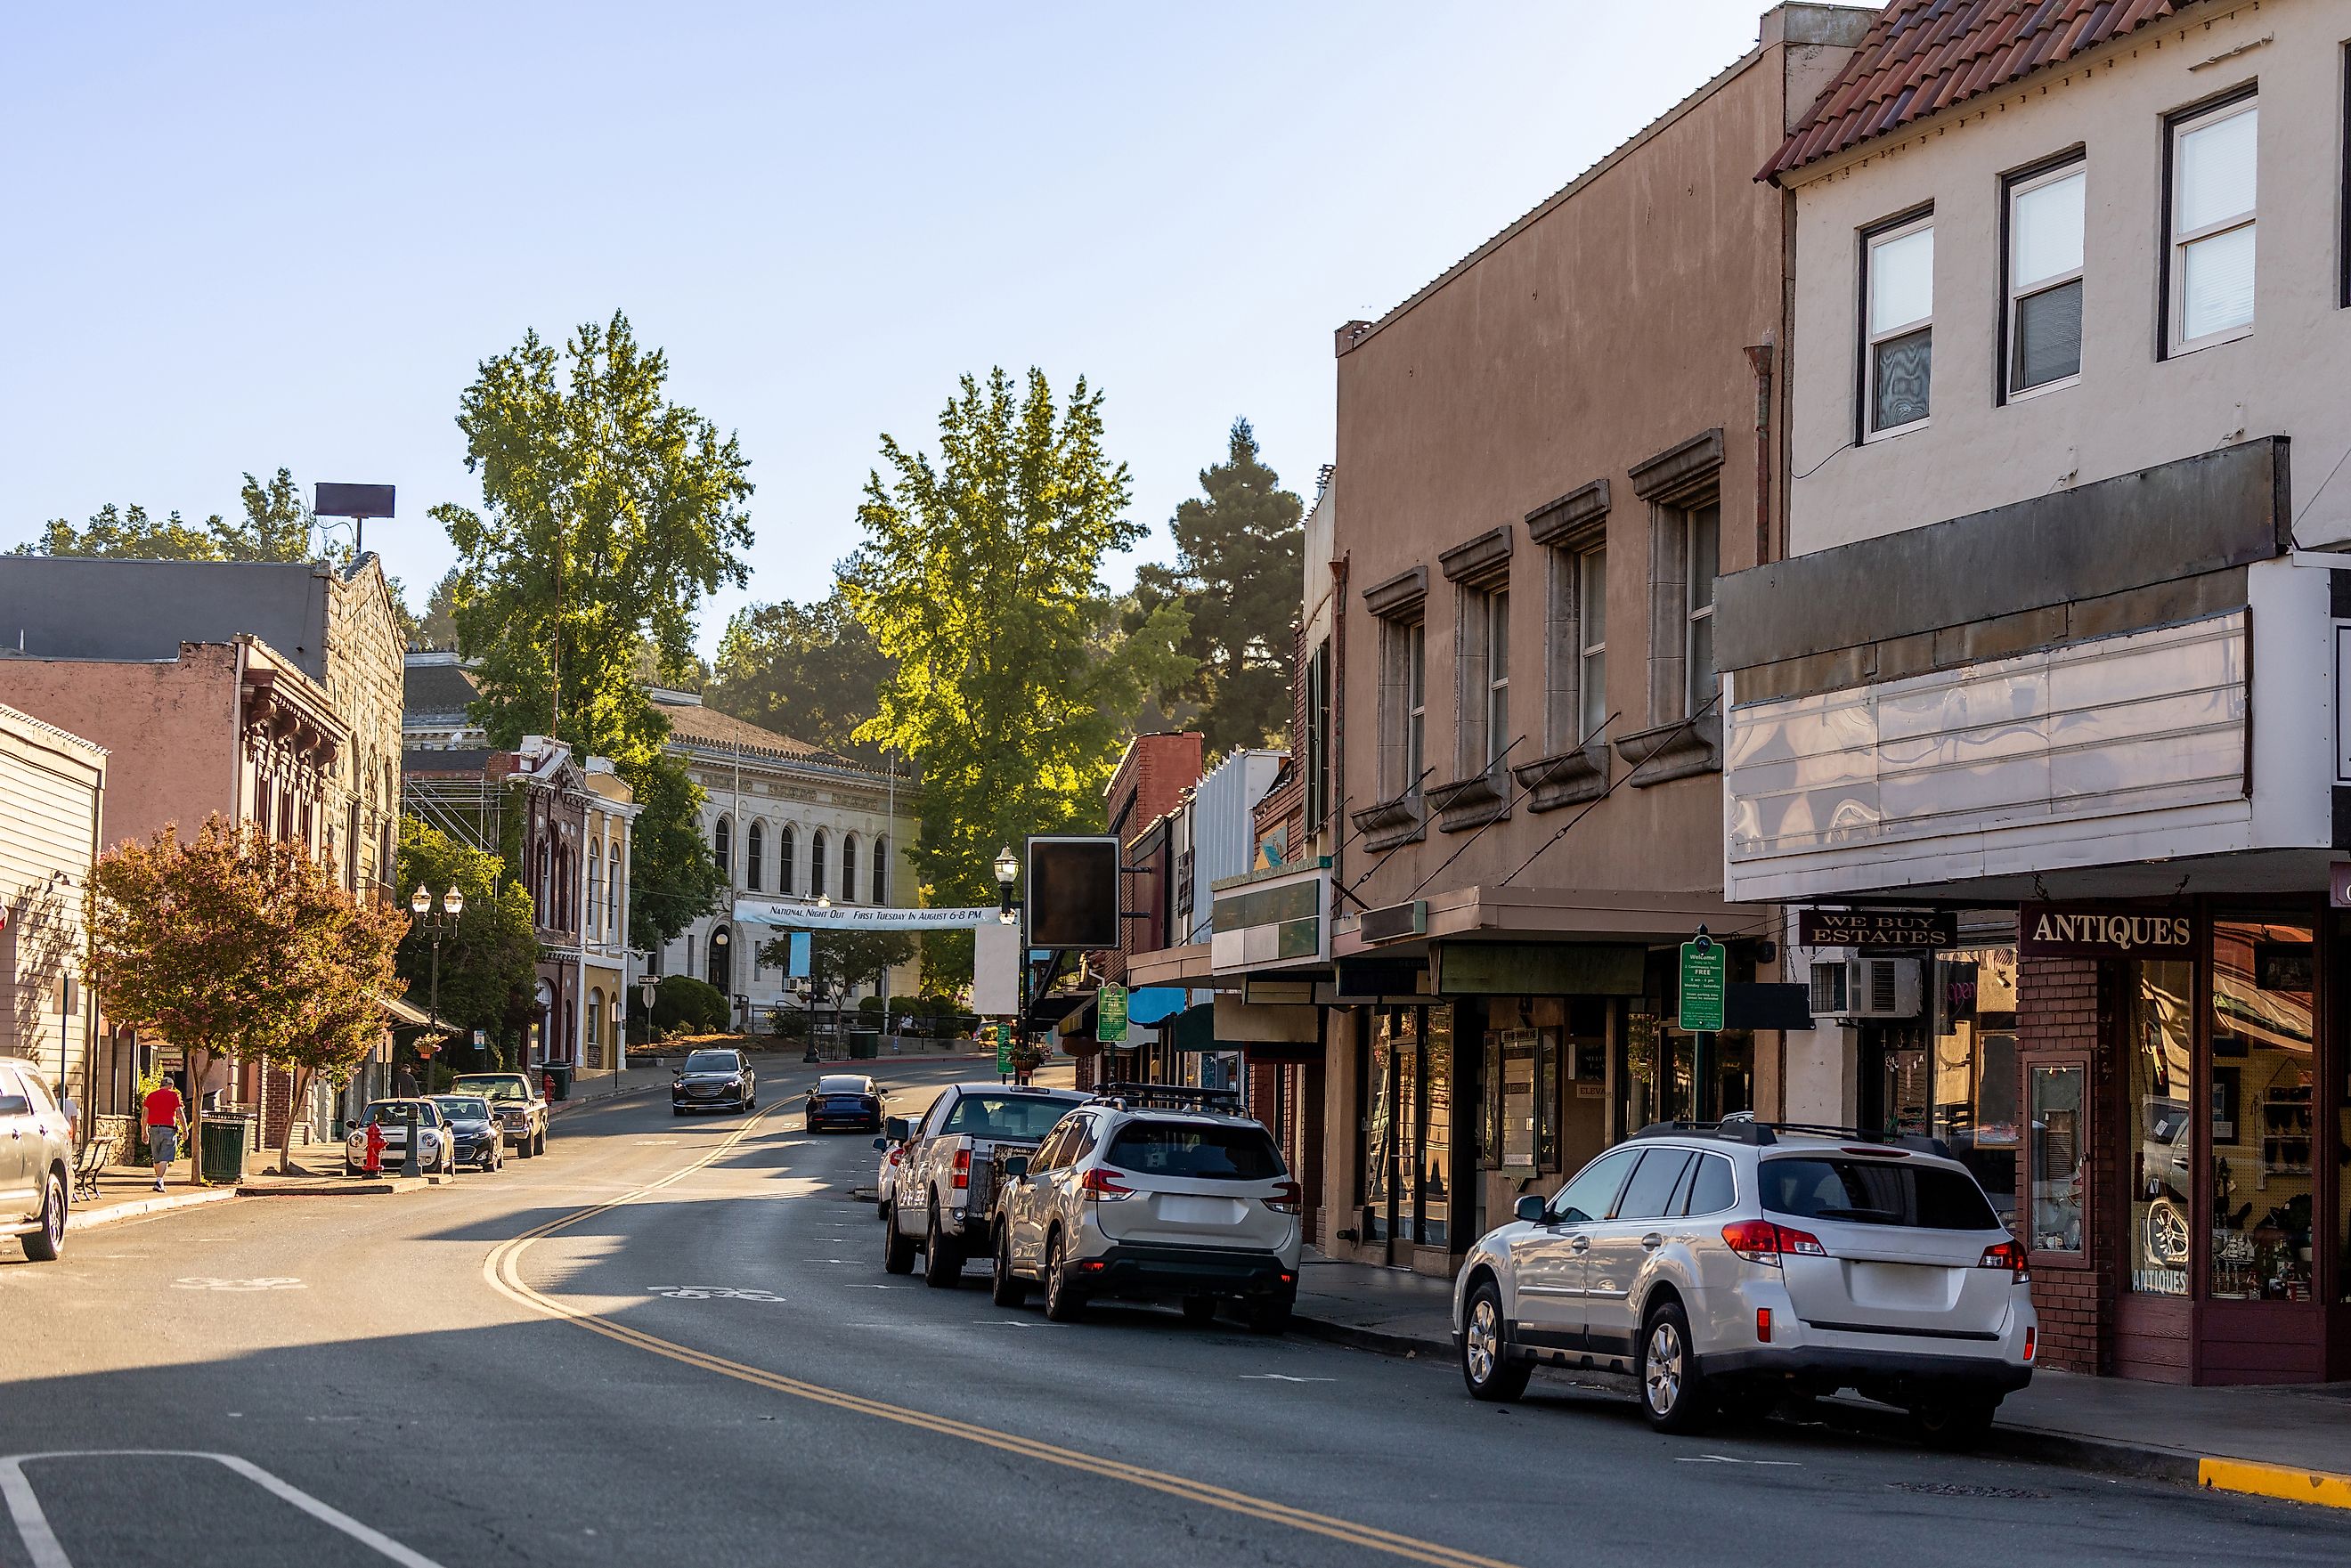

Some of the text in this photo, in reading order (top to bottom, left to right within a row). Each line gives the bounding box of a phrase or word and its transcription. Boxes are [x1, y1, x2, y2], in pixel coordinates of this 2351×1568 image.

[770, 906, 982, 921] NATIONAL NIGHT OUT FIRST TUESDAY IN AUGUST 6-8 PM
[1822, 915, 1935, 928] WE BUY
[1811, 929, 1948, 944] ESTATES
[2032, 914, 2191, 949] ANTIQUES
[1946, 982, 1976, 1004] open
[1580, 1087, 1607, 1095] ELEVA
[2132, 1269, 2186, 1295] ANTIQUES
